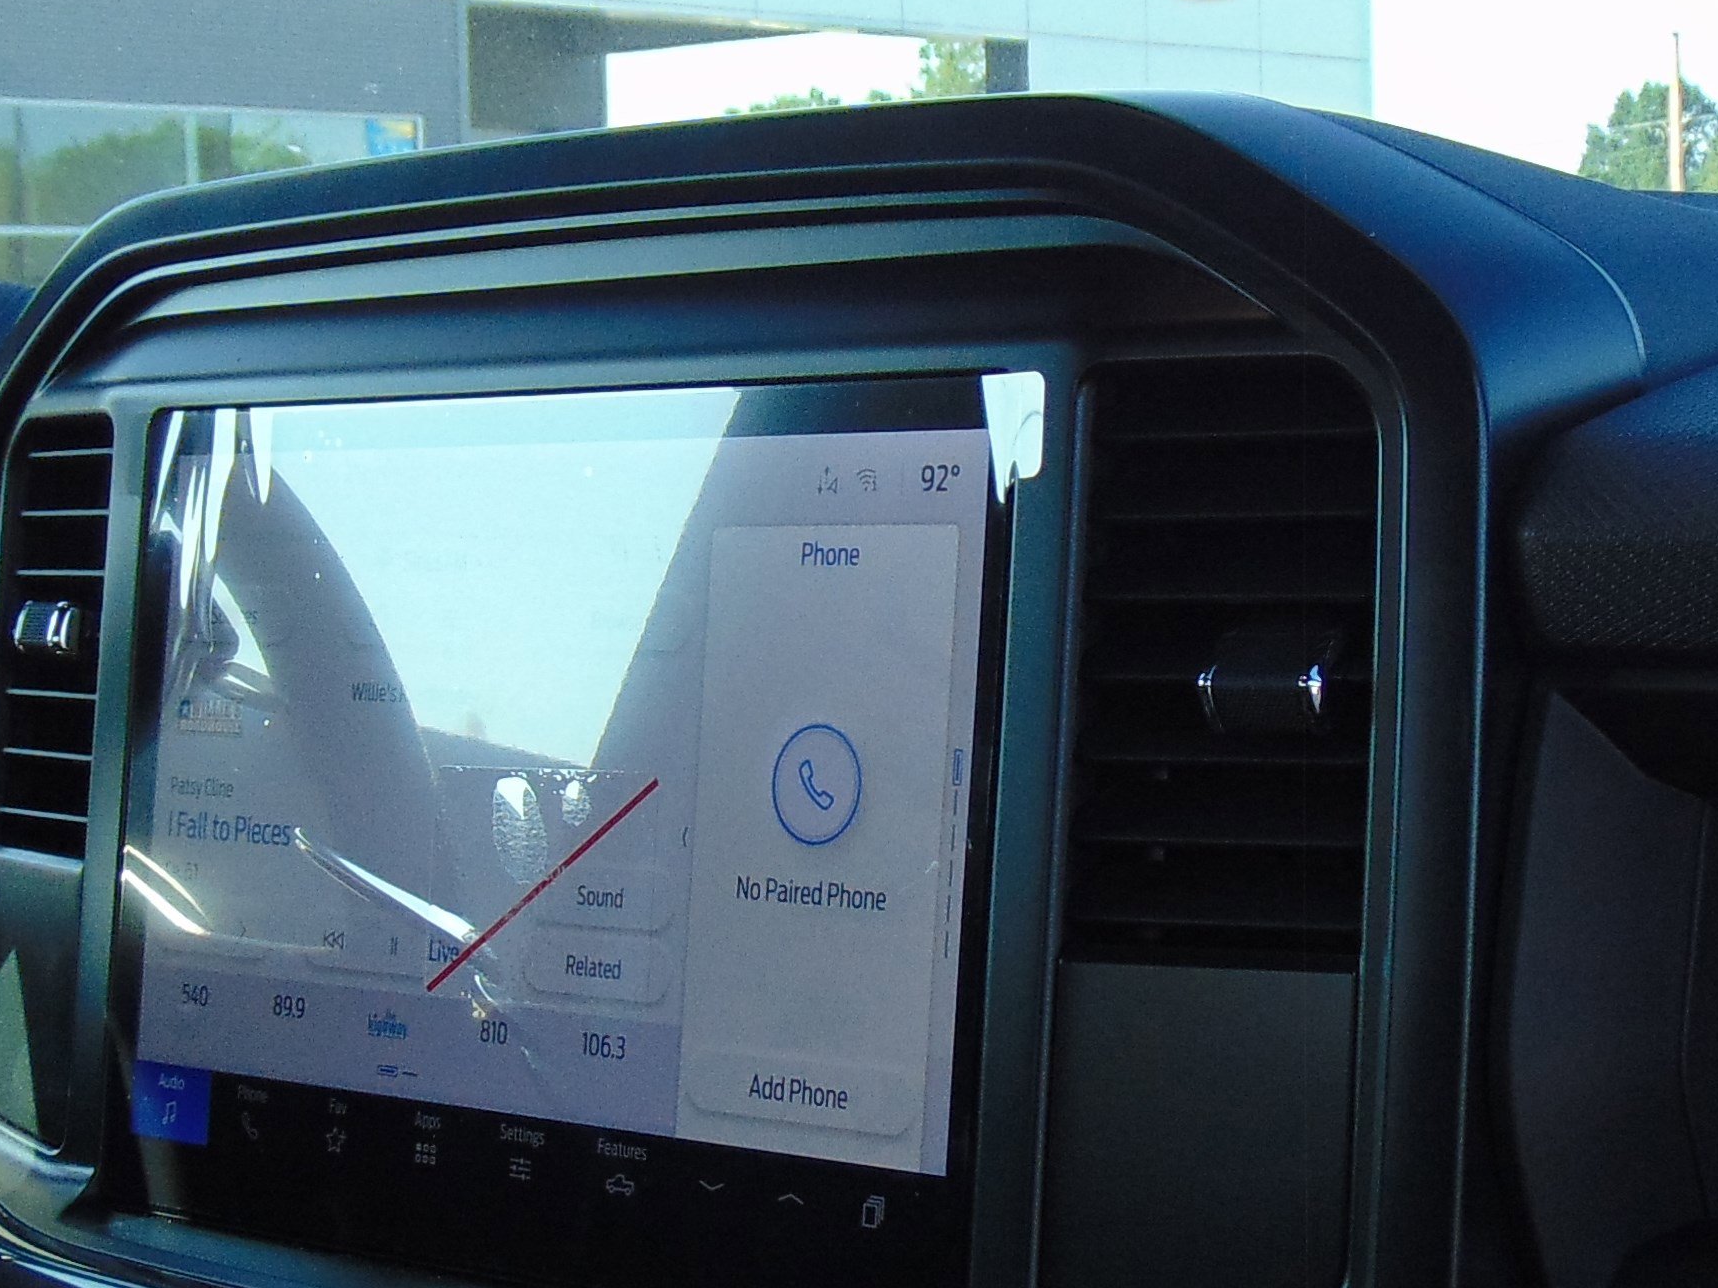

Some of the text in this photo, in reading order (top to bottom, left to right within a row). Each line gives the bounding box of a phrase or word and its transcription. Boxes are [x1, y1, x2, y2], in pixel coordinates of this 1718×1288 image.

[920, 463, 961, 492] 92°
[800, 540, 860, 566] Phone
[176, 811, 208, 841] Fall
[213, 814, 230, 842] to
[233, 815, 291, 847] Pieces
[576, 884, 625, 910] Sound
[736, 875, 887, 912] No Paired Phone
[428, 938, 459, 964] Live
[565, 954, 622, 981] Related
[182, 983, 209, 1007] 540
[272, 994, 306, 1019] 89.9
[479, 1019, 508, 1046] 810
[582, 1030, 627, 1061] 106.3
[157, 1072, 185, 1091] Audio
[748, 1073, 849, 1110] Add Phone
[414, 1110, 441, 1131] Apps
[499, 1122, 546, 1148] Settings
[596, 1137, 648, 1162] Features
